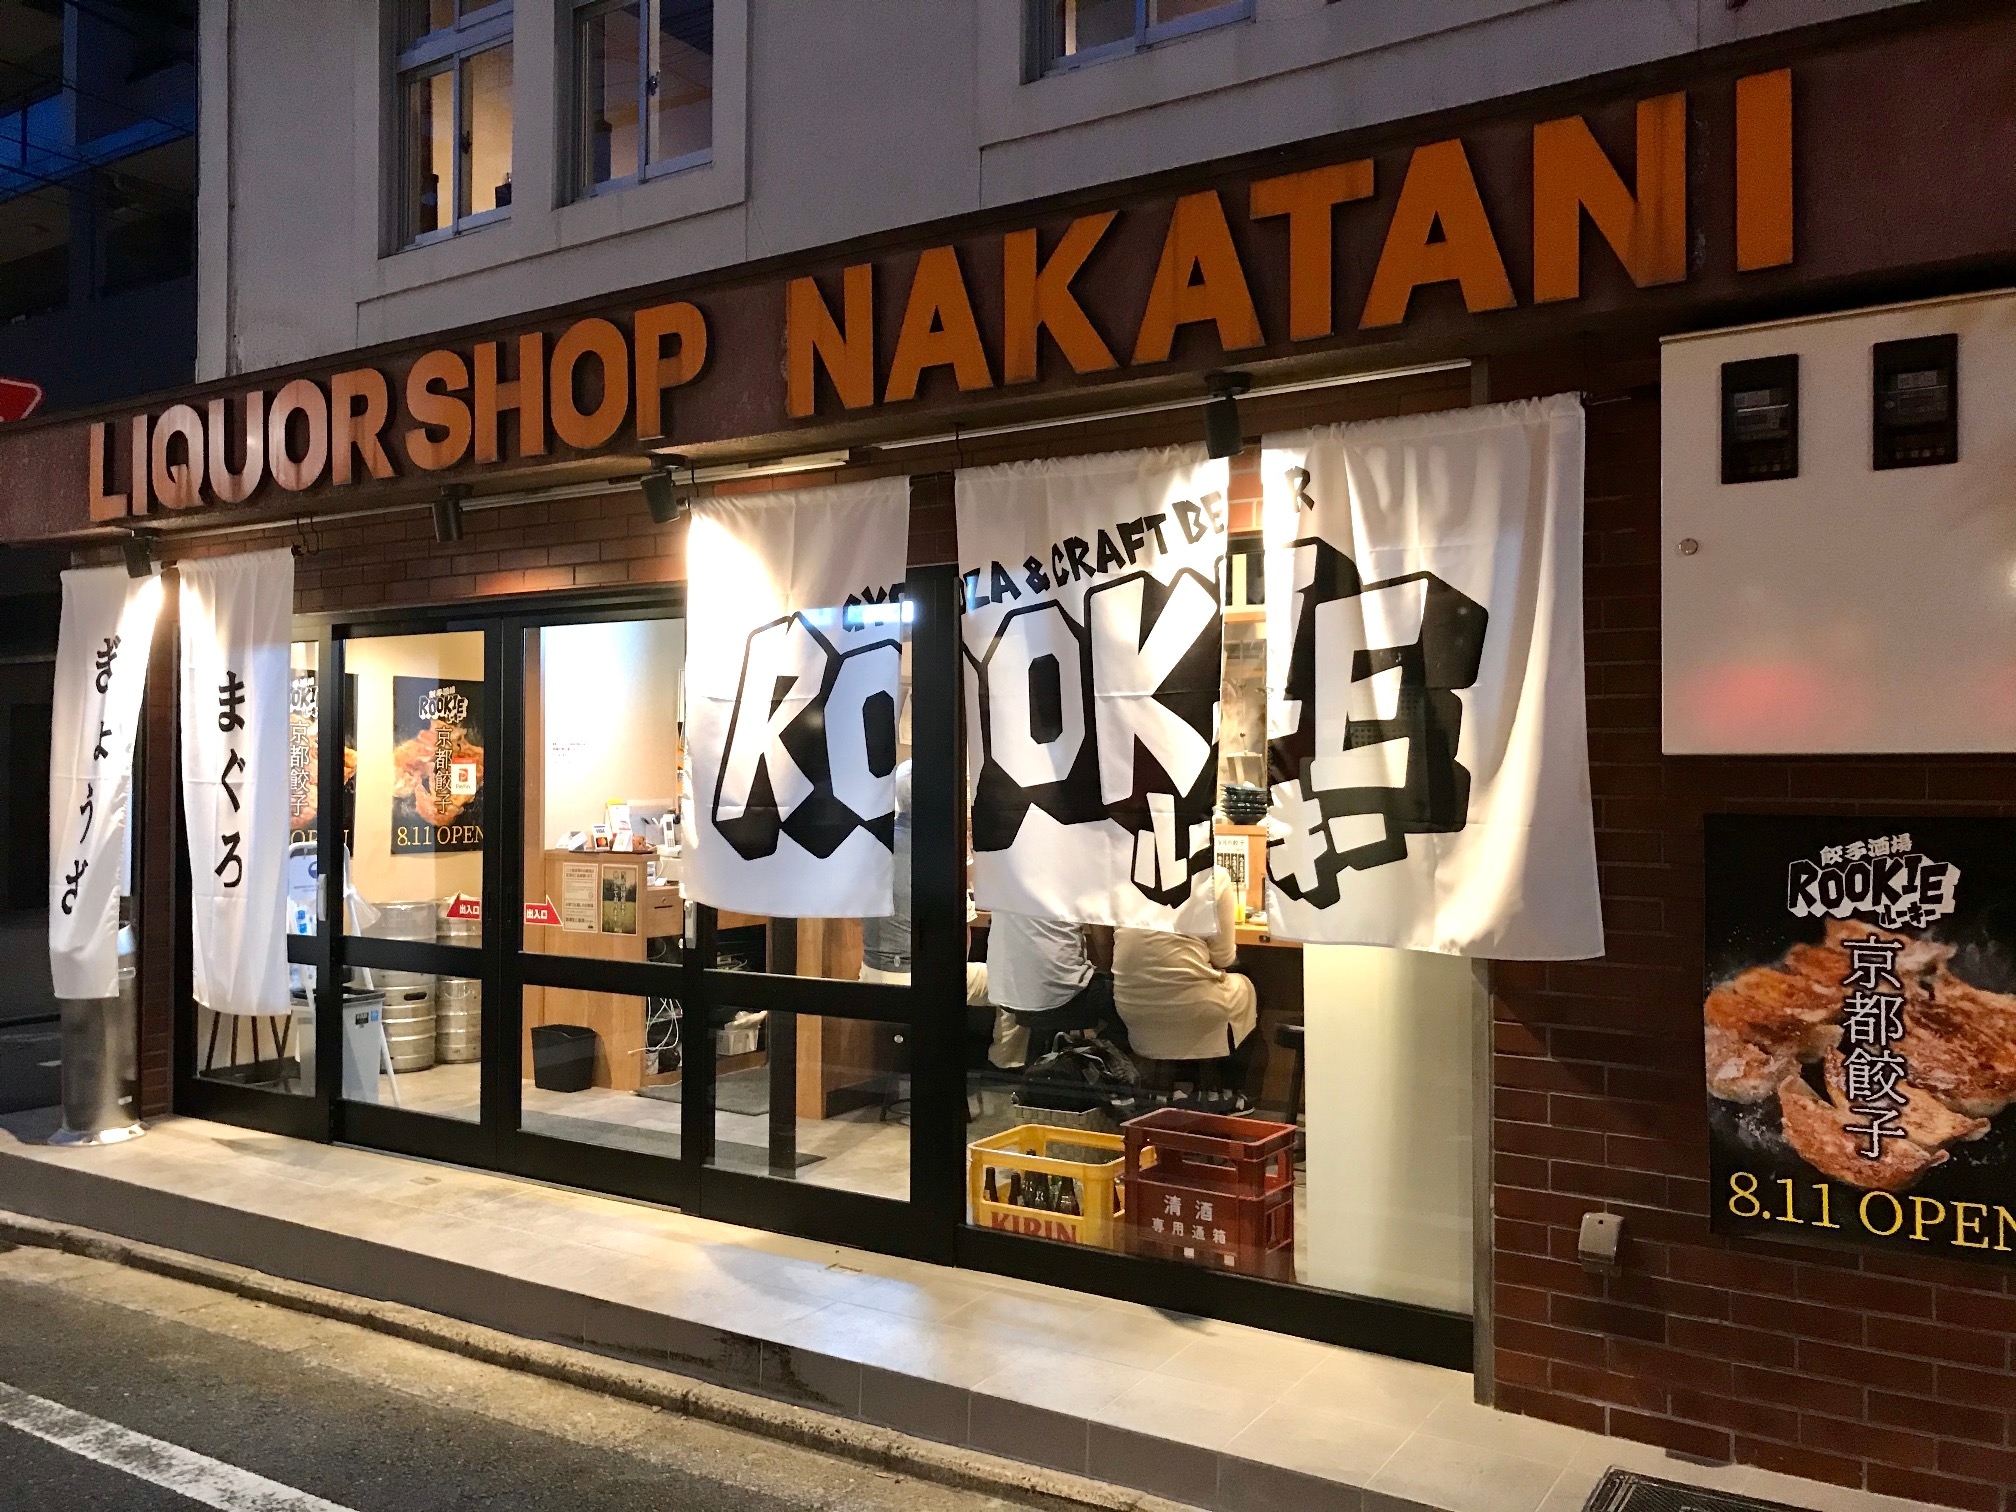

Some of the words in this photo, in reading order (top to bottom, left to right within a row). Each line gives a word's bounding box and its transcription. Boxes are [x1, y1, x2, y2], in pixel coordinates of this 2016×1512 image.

[90, 368, 395, 521] LIQUOR
[405, 302, 708, 471] SHOP
[786, 68, 1793, 418] NAKATANI
[1050, 513, 1169, 588] CRAFT
[1171, 465, 1315, 545] BER
[418, 693, 469, 720] ROOKIE
[711, 536, 1489, 861] ROOKIE
[61, 635, 121, 915] ぎょうざ
[214, 670, 246, 888] まぐろ
[434, 725, 453, 814] 京都餃子
[397, 826, 432, 846] 8.11
[459, 903, 480, 915] 出入口
[526, 908, 548, 920] 出入口
[1788, 854, 1961, 918] ROOKIE
[1842, 935, 1907, 1159] 京都餃子
[990, 1211, 1077, 1243] KIRIN
[1729, 1171, 1840, 1229] 8.11
